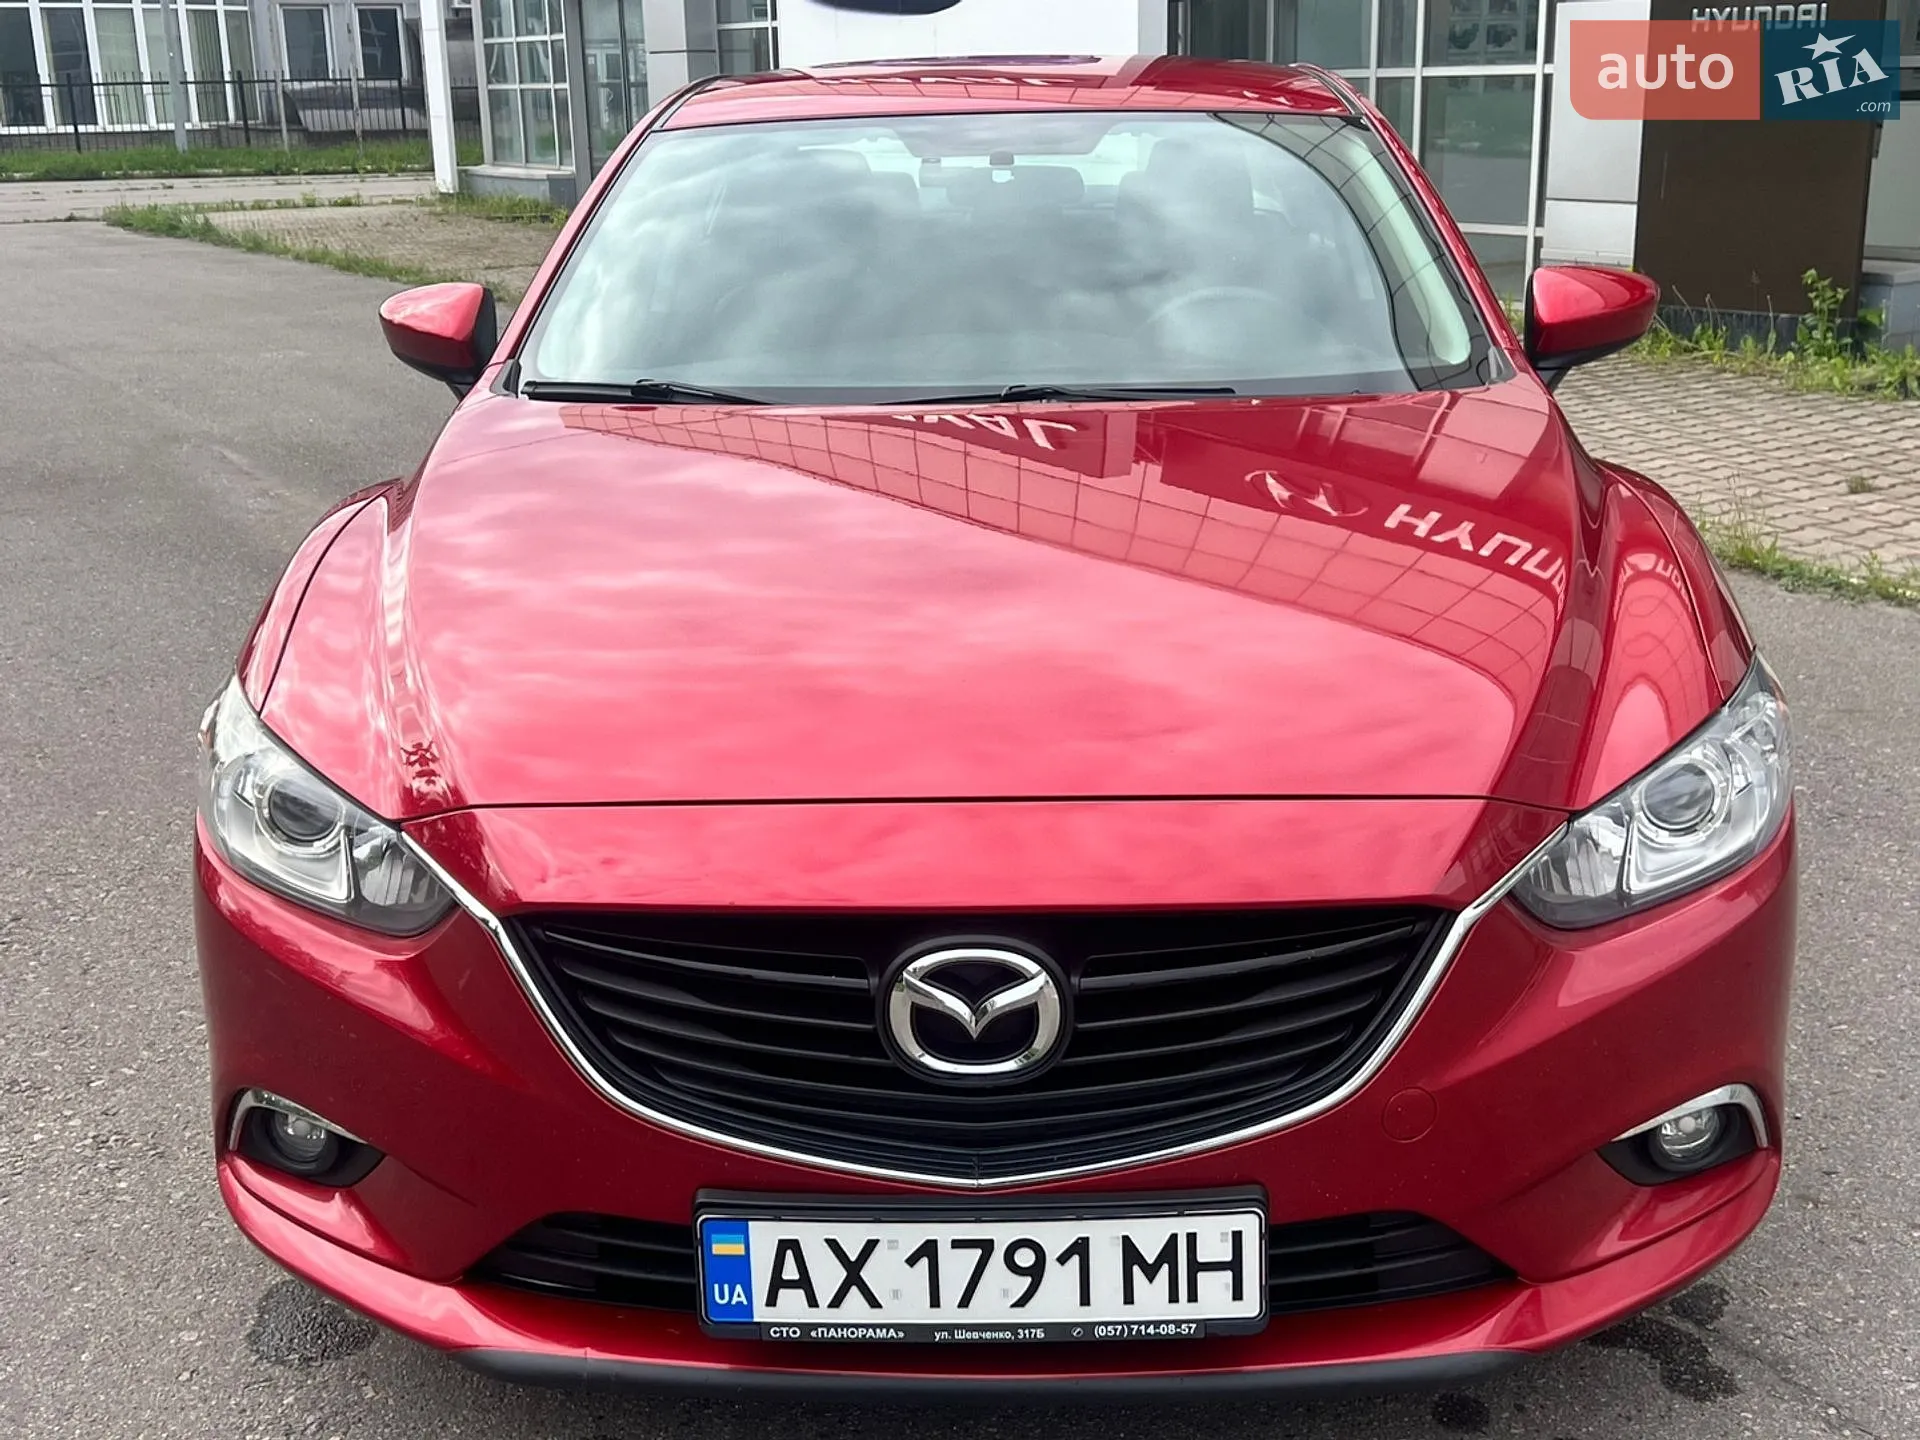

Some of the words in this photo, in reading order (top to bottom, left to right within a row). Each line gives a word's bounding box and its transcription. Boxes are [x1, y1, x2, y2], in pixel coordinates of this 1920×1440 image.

[1691, 3, 1828, 32] HYUNDAI
[764, 1237, 884, 1310] AX
[903, 1236, 1092, 1310] 1791
[1120, 1230, 1245, 1306] MH
[713, 1284, 747, 1306] UA
[770, 1326, 801, 1339] СТО
[810, 1326, 905, 1340] «ПАНОРАМА»
[934, 1330, 951, 1343] ул.
[954, 1329, 1015, 1342] Шевченко,
[1017, 1328, 1046, 1340] 317Б
[1094, 1325, 1128, 1339] (057)
[1131, 1323, 1198, 1337] 714-08-57
